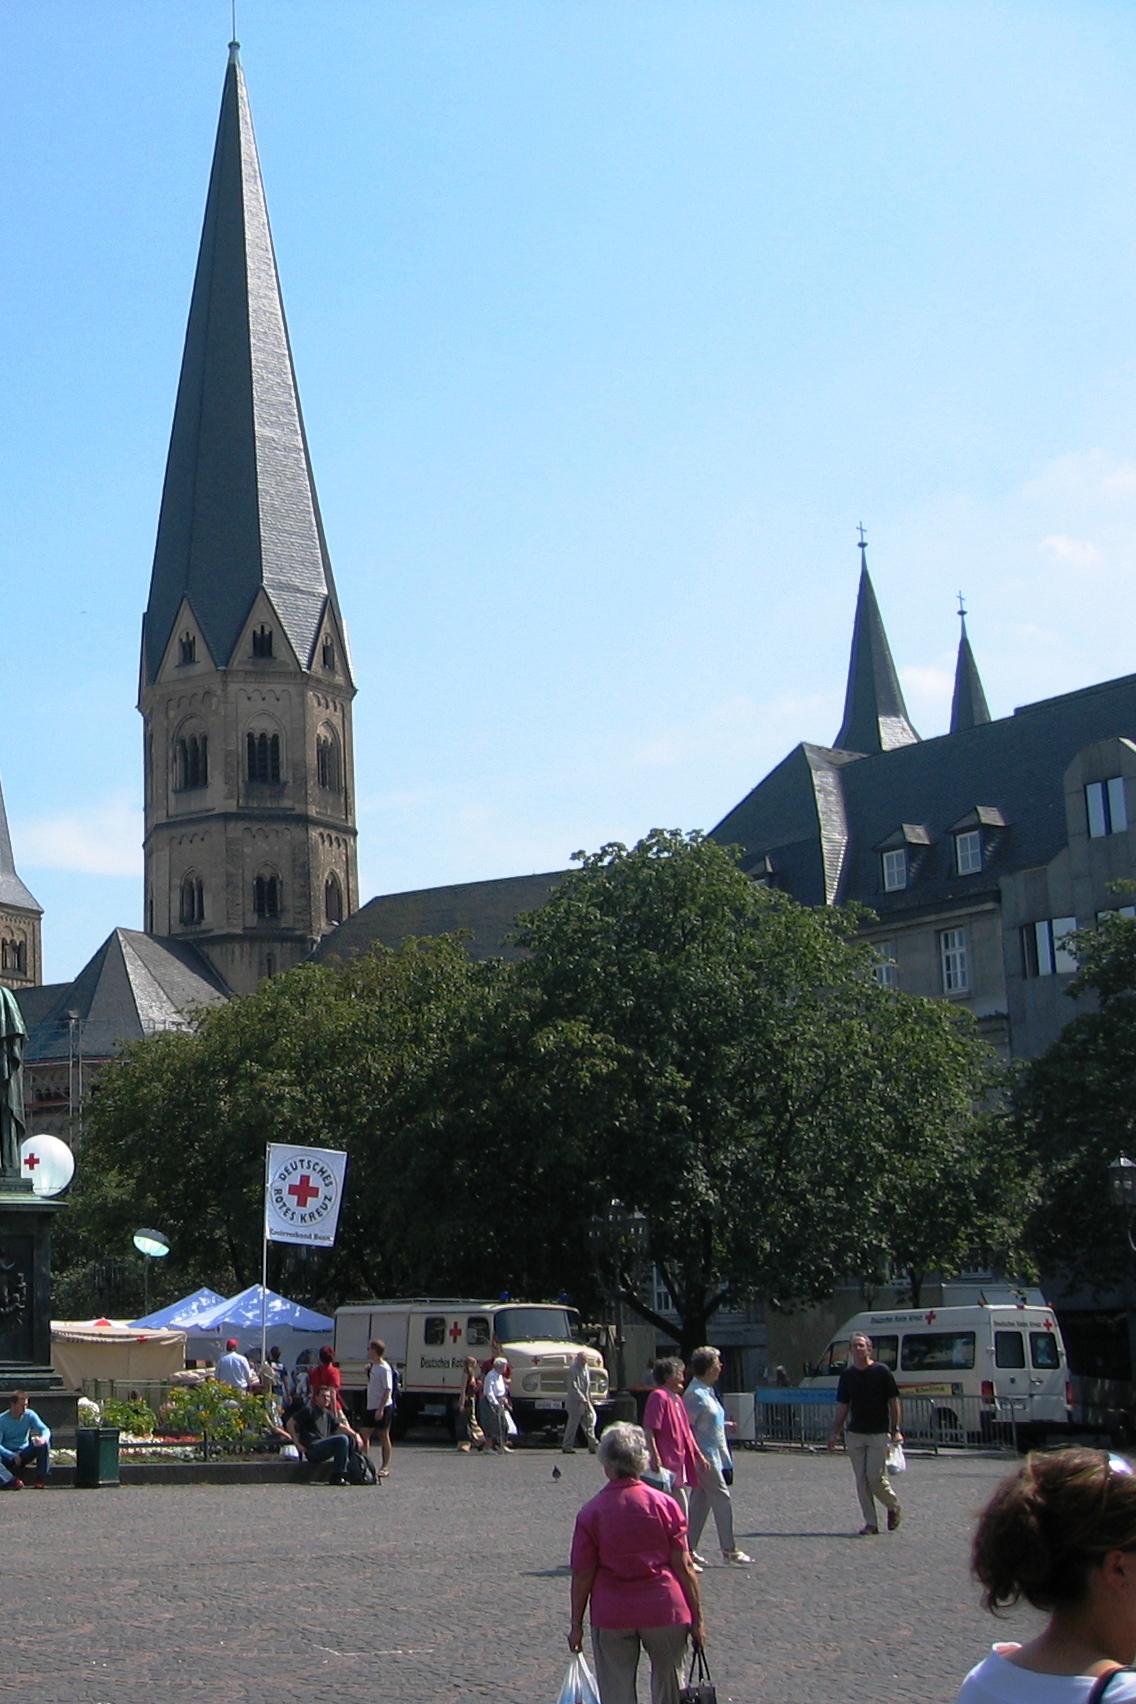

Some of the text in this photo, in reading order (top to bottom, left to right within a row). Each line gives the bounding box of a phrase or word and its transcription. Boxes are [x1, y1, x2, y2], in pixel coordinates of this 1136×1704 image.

[279, 1160, 333, 1187] DEUTSCHES
[274, 1188, 333, 1224] ROTES KREUZ
[420, 1357, 450, 1369] Deutsches
